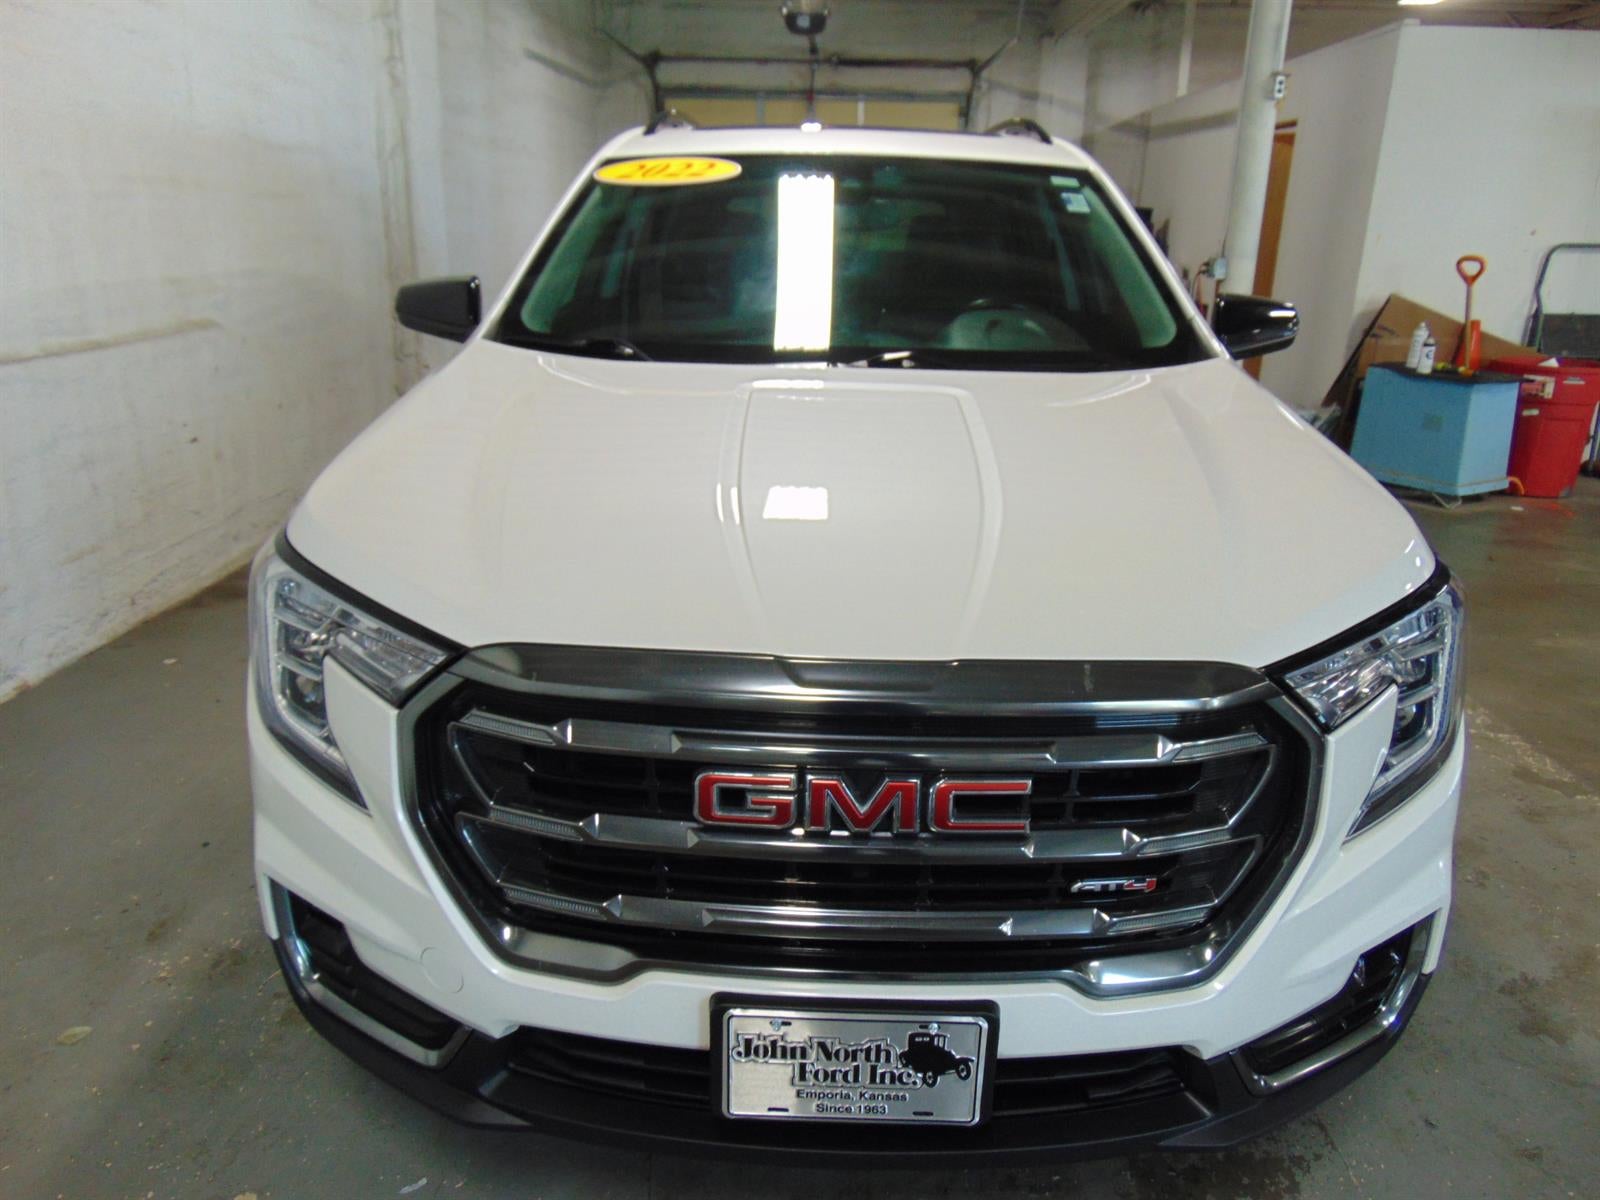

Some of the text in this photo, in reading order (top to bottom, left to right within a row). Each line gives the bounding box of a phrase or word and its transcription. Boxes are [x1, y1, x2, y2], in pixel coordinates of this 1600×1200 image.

[614, 162, 718, 179] 2022
[694, 772, 1033, 834] GMC
[1070, 877, 1157, 893] AT4
[735, 1036, 894, 1064] John North
[798, 1062, 919, 1087] Ford Inc.
[796, 1088, 909, 1102] Emporia, Kansas
[815, 1102, 888, 1116] Since 1963
